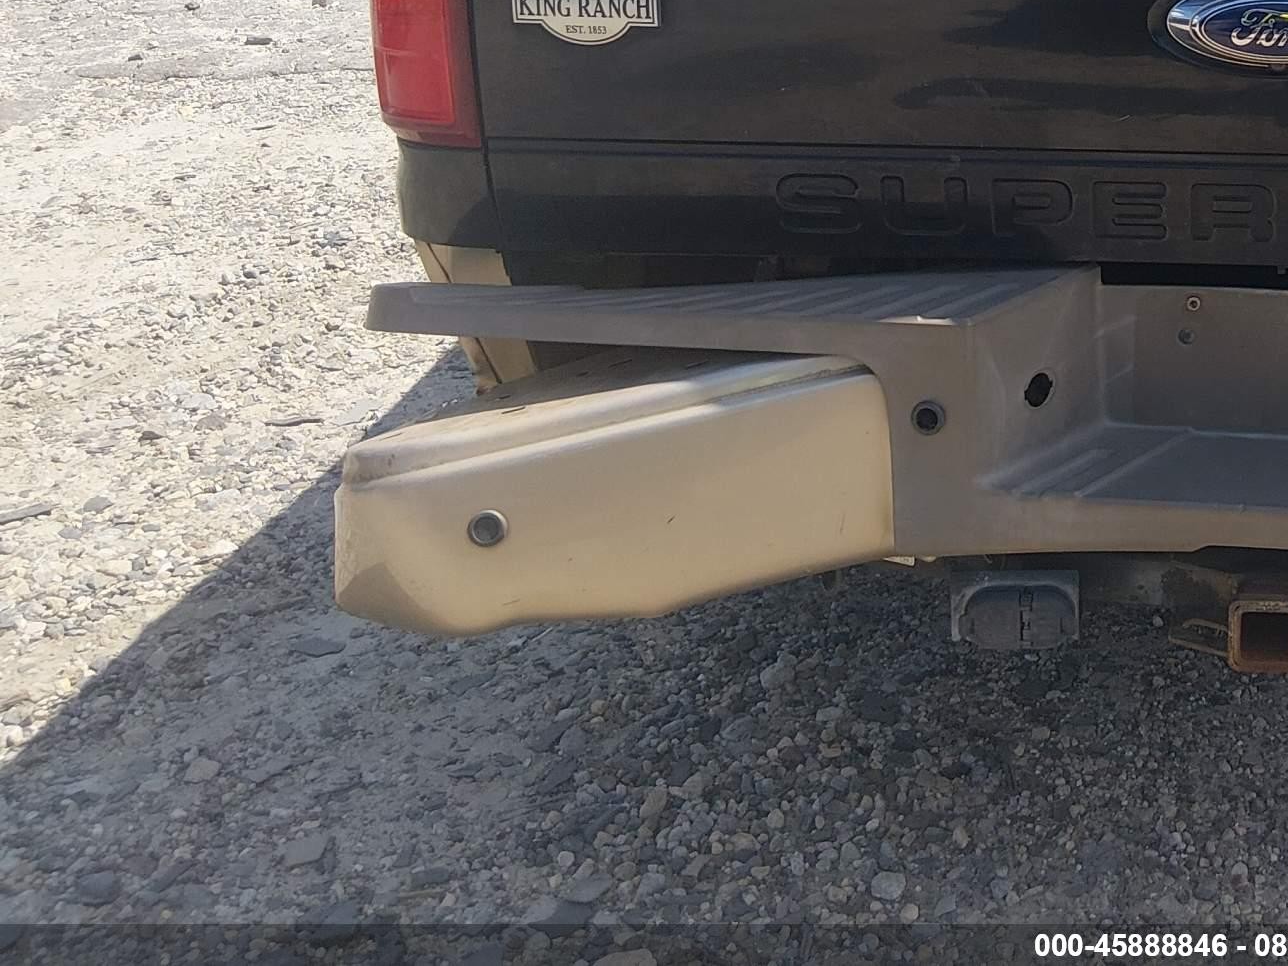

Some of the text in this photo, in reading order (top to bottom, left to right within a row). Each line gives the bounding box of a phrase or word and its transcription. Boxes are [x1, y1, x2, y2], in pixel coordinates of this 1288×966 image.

[565, 24, 608, 36] EST. 1853
[774, 171, 1282, 243] SUPER
